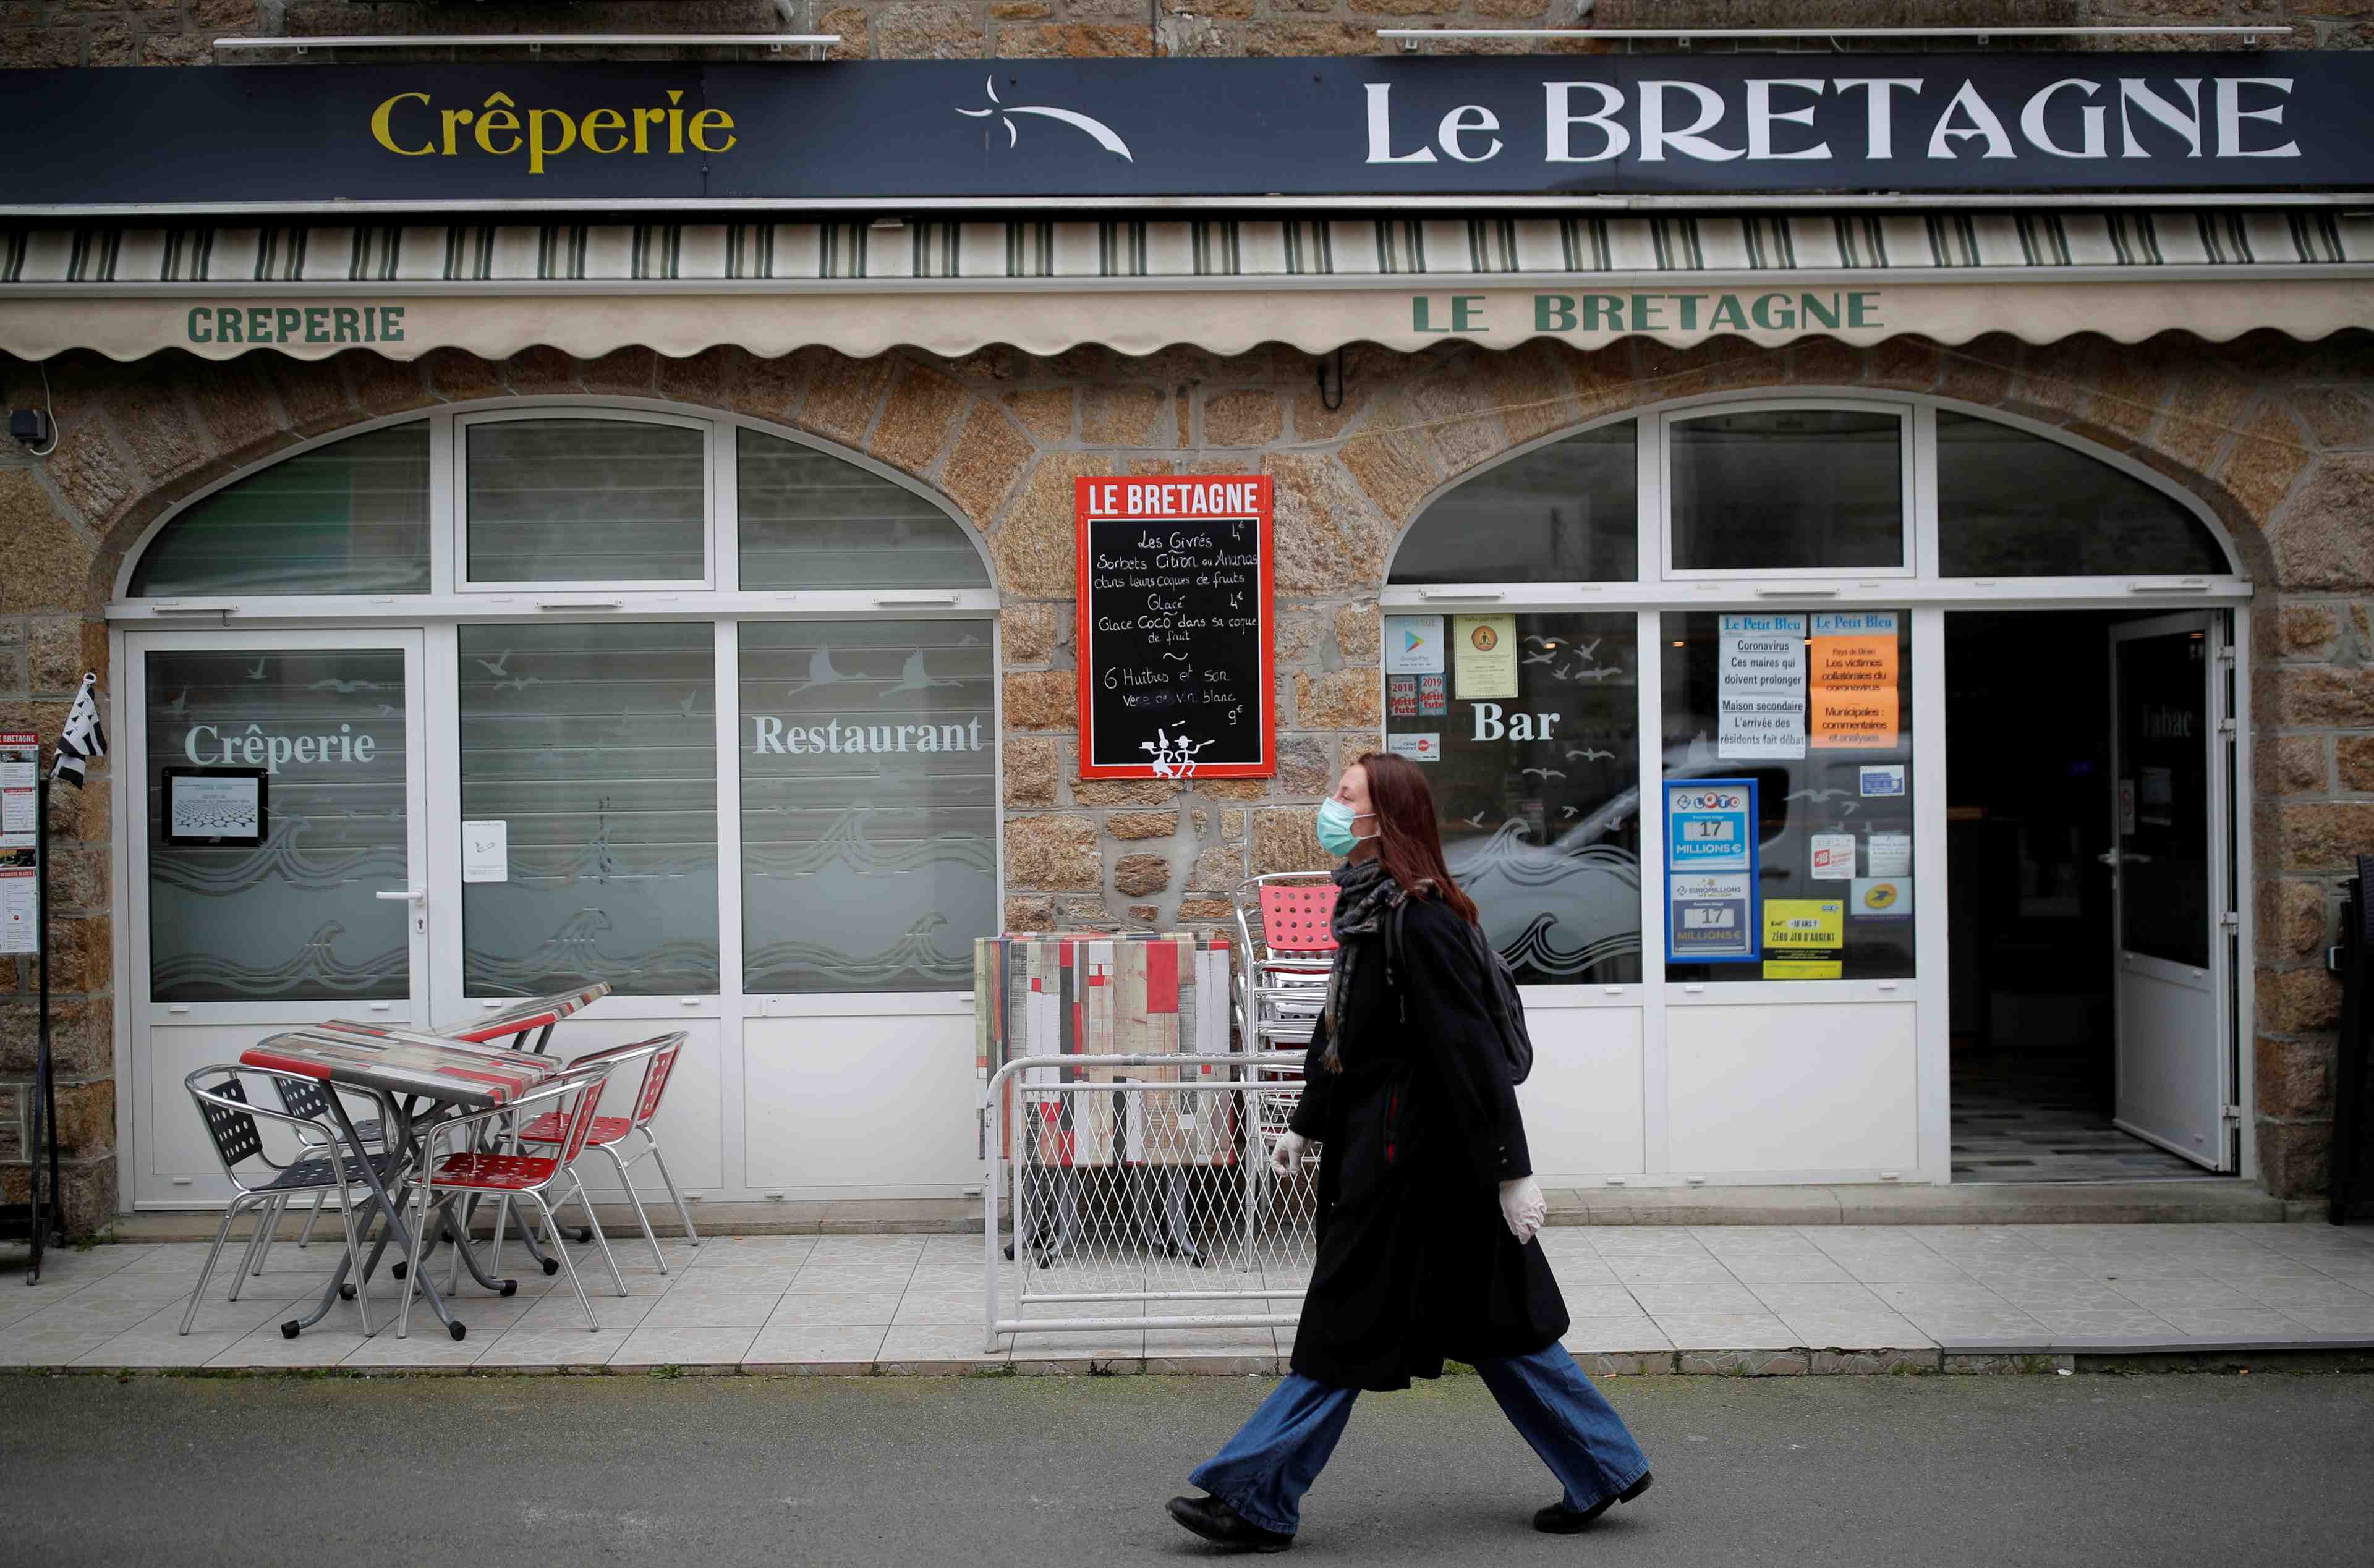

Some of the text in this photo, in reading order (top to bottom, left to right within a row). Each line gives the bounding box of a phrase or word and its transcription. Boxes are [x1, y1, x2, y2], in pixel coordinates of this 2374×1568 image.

[1364, 78, 2302, 163] Le BRETAGNE
[370, 90, 737, 174] Crêperie
[1413, 290, 1884, 332] LE BRETAGNE
[188, 307, 405, 343] CREPERIE
[1089, 483, 1257, 514] LE BRETAGNE
[1138, 530, 1212, 549] Les Givrés
[1097, 549, 1257, 569] Sorbets Citron ou Ananas
[1094, 575, 1125, 588] dans
[1130, 575, 1154, 587] leurs
[1196, 572, 1210, 585] de
[1213, 571, 1244, 588] fruits
[1147, 593, 1186, 611] Glacé
[1099, 617, 1133, 631] Glace
[1177, 614, 1206, 628] dans
[1212, 617, 1224, 627] sa
[1228, 617, 1257, 635] coque
[1724, 616, 1801, 630] Le Petit Bleu
[1816, 614, 1892, 629] Le Petit Bleu
[1148, 630, 1191, 645] de fruit
[1738, 640, 1790, 651] Coronavirus
[1731, 657, 1796, 669] Ces maires qui
[1826, 658, 1883, 668] Les victimes
[1104, 667, 1117, 689] 6
[1179, 664, 1193, 680] et
[1423, 677, 1442, 687] 2019
[1725, 674, 1802, 688] doivent prolonger
[1874, 671, 1886, 680] du
[1392, 683, 1414, 692] 2018
[1203, 690, 1236, 703] blanc
[1722, 700, 1803, 711] Maison secondaire
[1825, 706, 1879, 718] Municipales
[1471, 703, 1560, 741] Bar
[1735, 717, 1790, 727] L'arrivée des
[1822, 721, 1887, 730] commentaires
[752, 715, 984, 755] Restaurant
[1721, 734, 1759, 745] résidents
[1763, 734, 1777, 745] fait
[185, 724, 375, 774] Crêperie
[1694, 792, 1740, 809] LOTO
[1701, 821, 1722, 836] 17
[1677, 844, 1730, 854] MILLIONS
[1689, 886, 1741, 894] EUROMILLIONS
[1702, 908, 1724, 923] 17
[1677, 930, 1732, 940] MILLIONS
